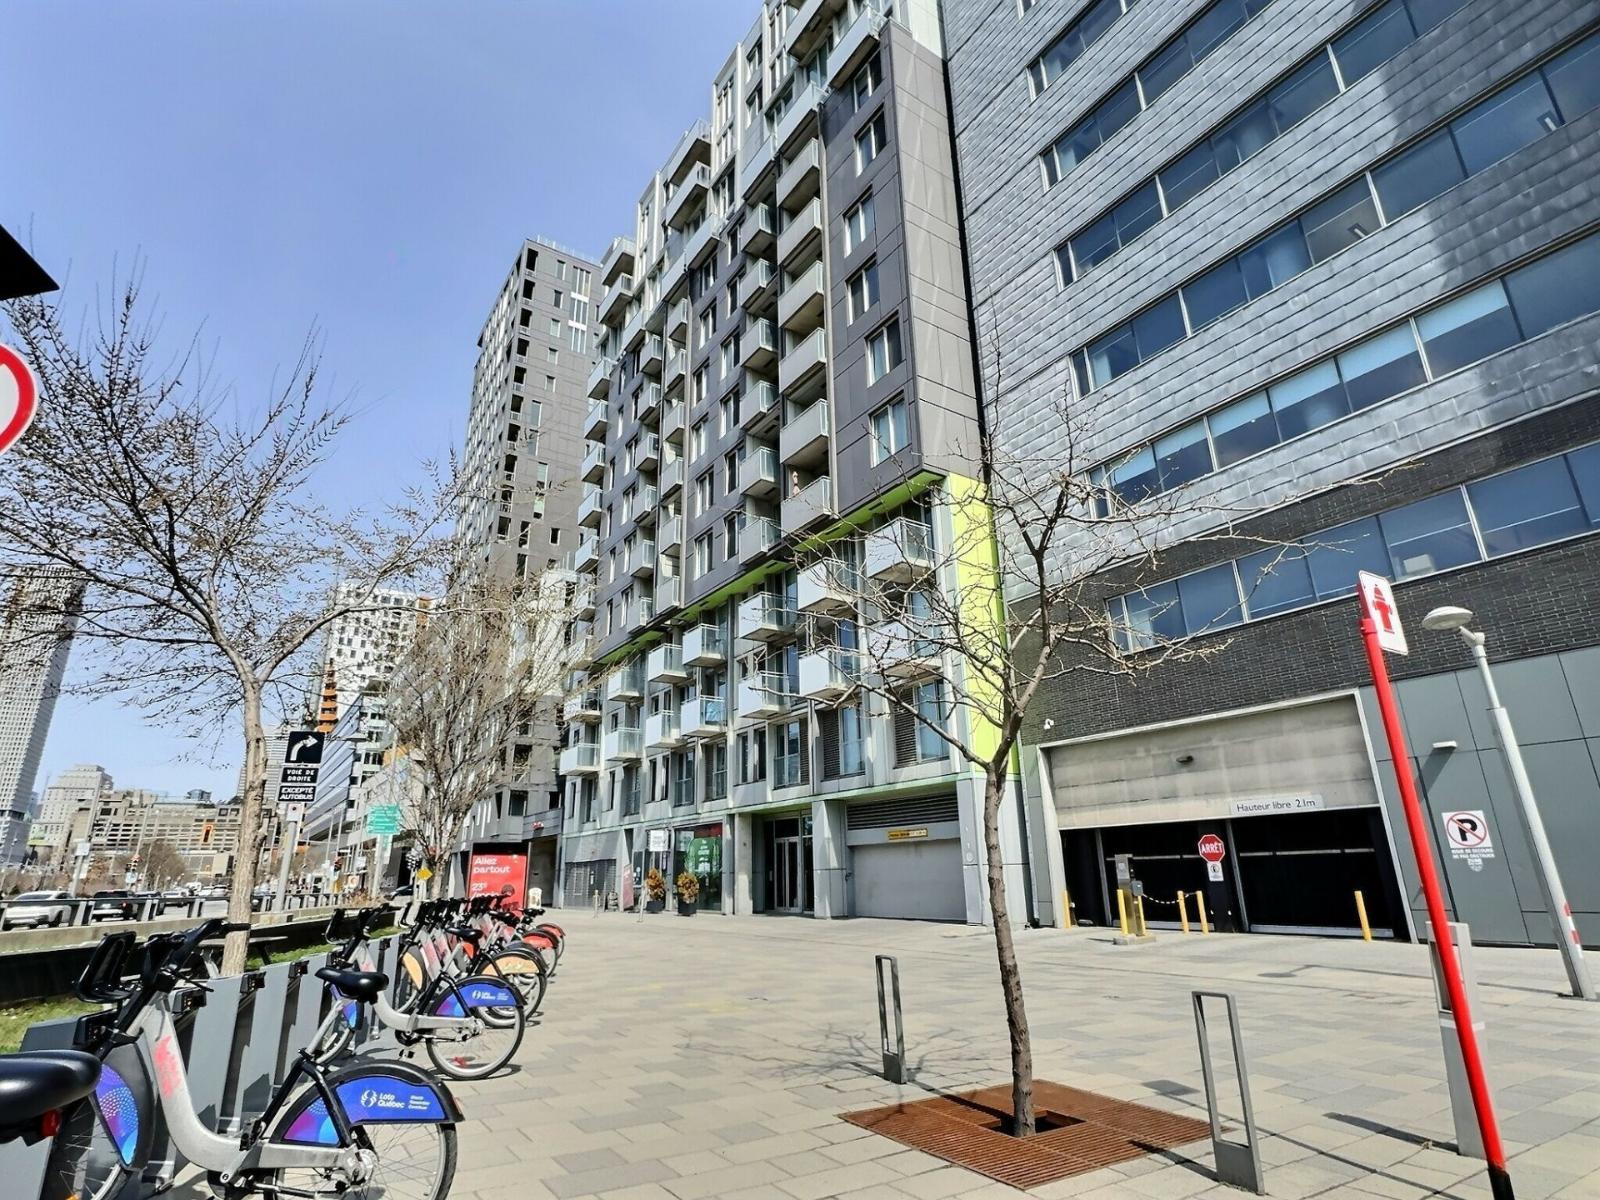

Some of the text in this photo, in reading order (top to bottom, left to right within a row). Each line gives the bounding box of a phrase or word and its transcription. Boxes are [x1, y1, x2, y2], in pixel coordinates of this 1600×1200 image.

[1236, 801, 1272, 812] Hauteur
[1272, 800, 1292, 810] libre
[1201, 842, 1222, 854] ARRÊT
[473, 866, 512, 874] partout
[379, 1092, 396, 1100] Loto
[378, 1100, 404, 1108] Québec
